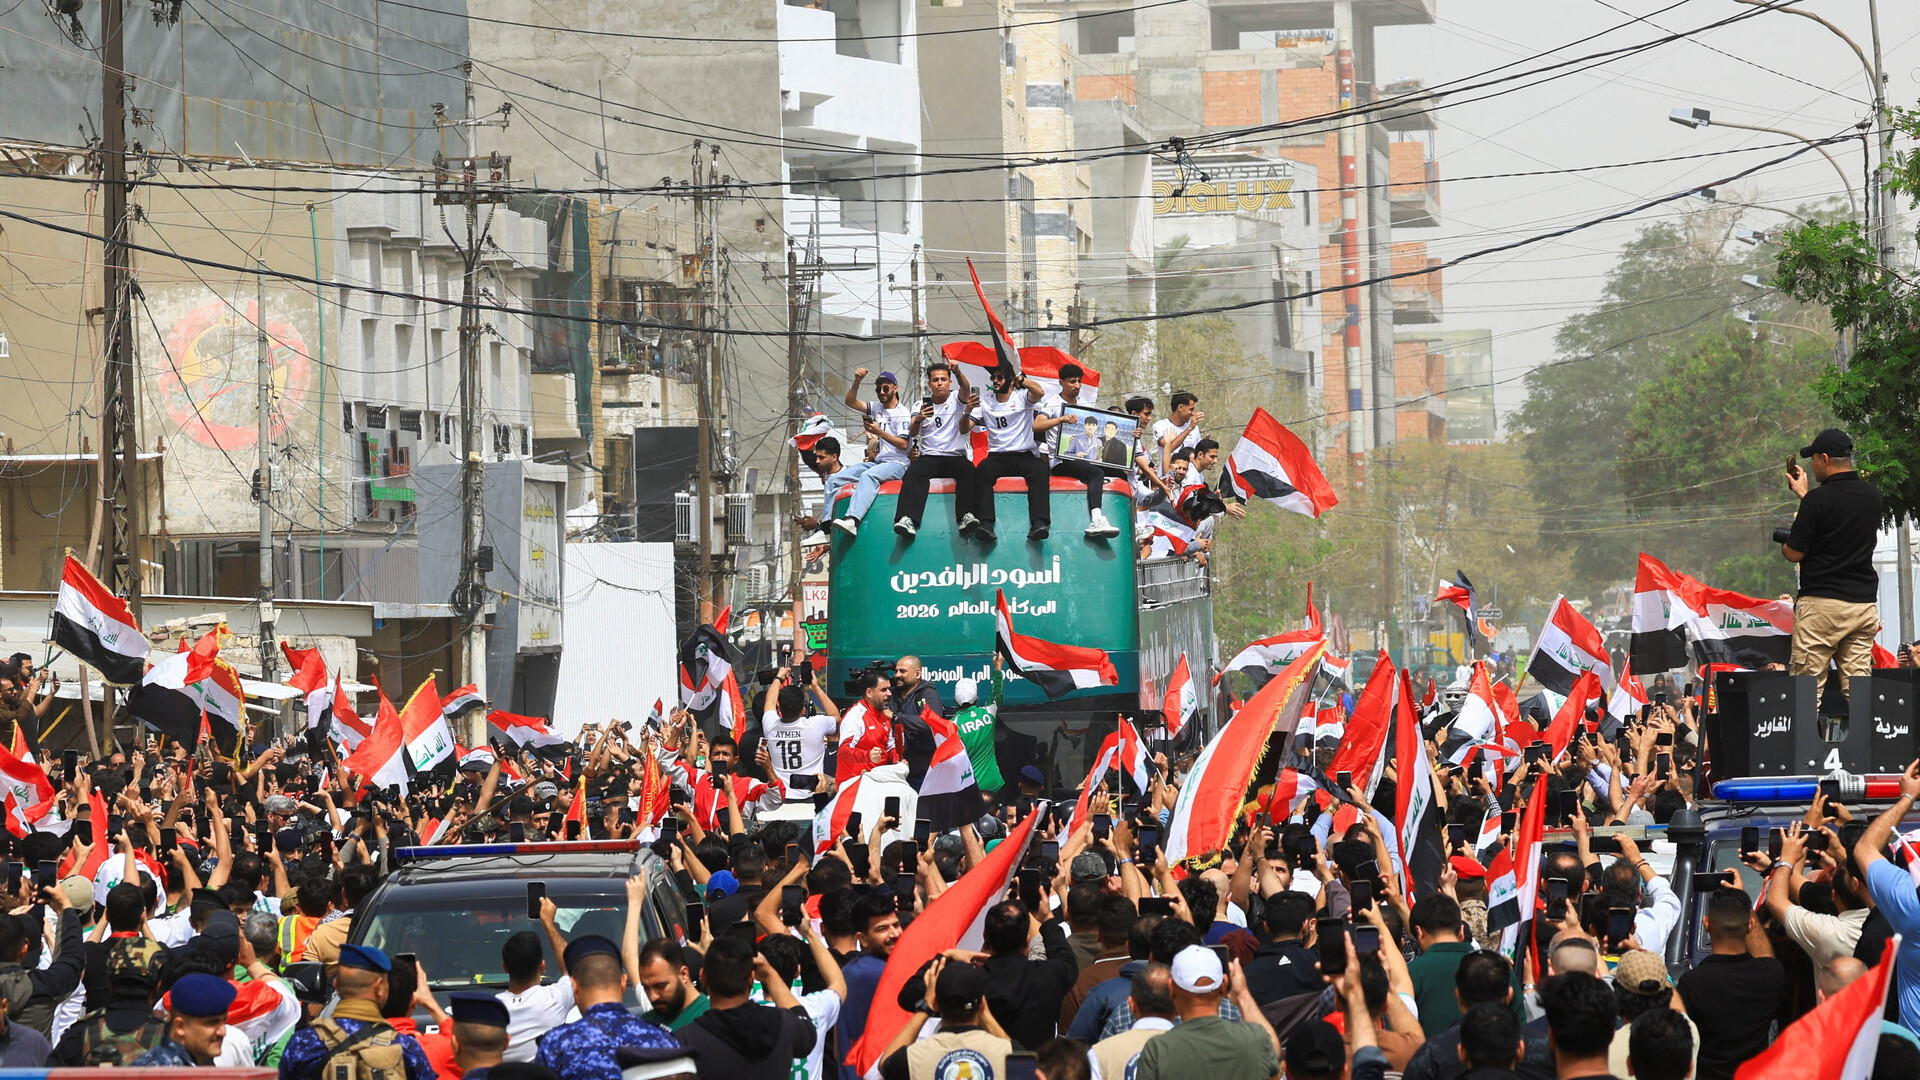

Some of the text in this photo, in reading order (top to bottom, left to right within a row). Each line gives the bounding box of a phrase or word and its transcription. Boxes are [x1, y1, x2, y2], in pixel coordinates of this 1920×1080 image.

[1193, 163, 1293, 180] CRYSTAL
[935, 416, 942, 428] 8
[995, 416, 1008, 428] 18
[890, 554, 1061, 594] أسود الرافدين
[896, 603, 940, 618] 2026
[948, 600, 989, 617] العالم
[961, 714, 992, 734] IRAQ
[1754, 716, 1908, 739] سرية المغاوير
[776, 740, 802, 770] 18
[1824, 748, 1842, 770] 4
